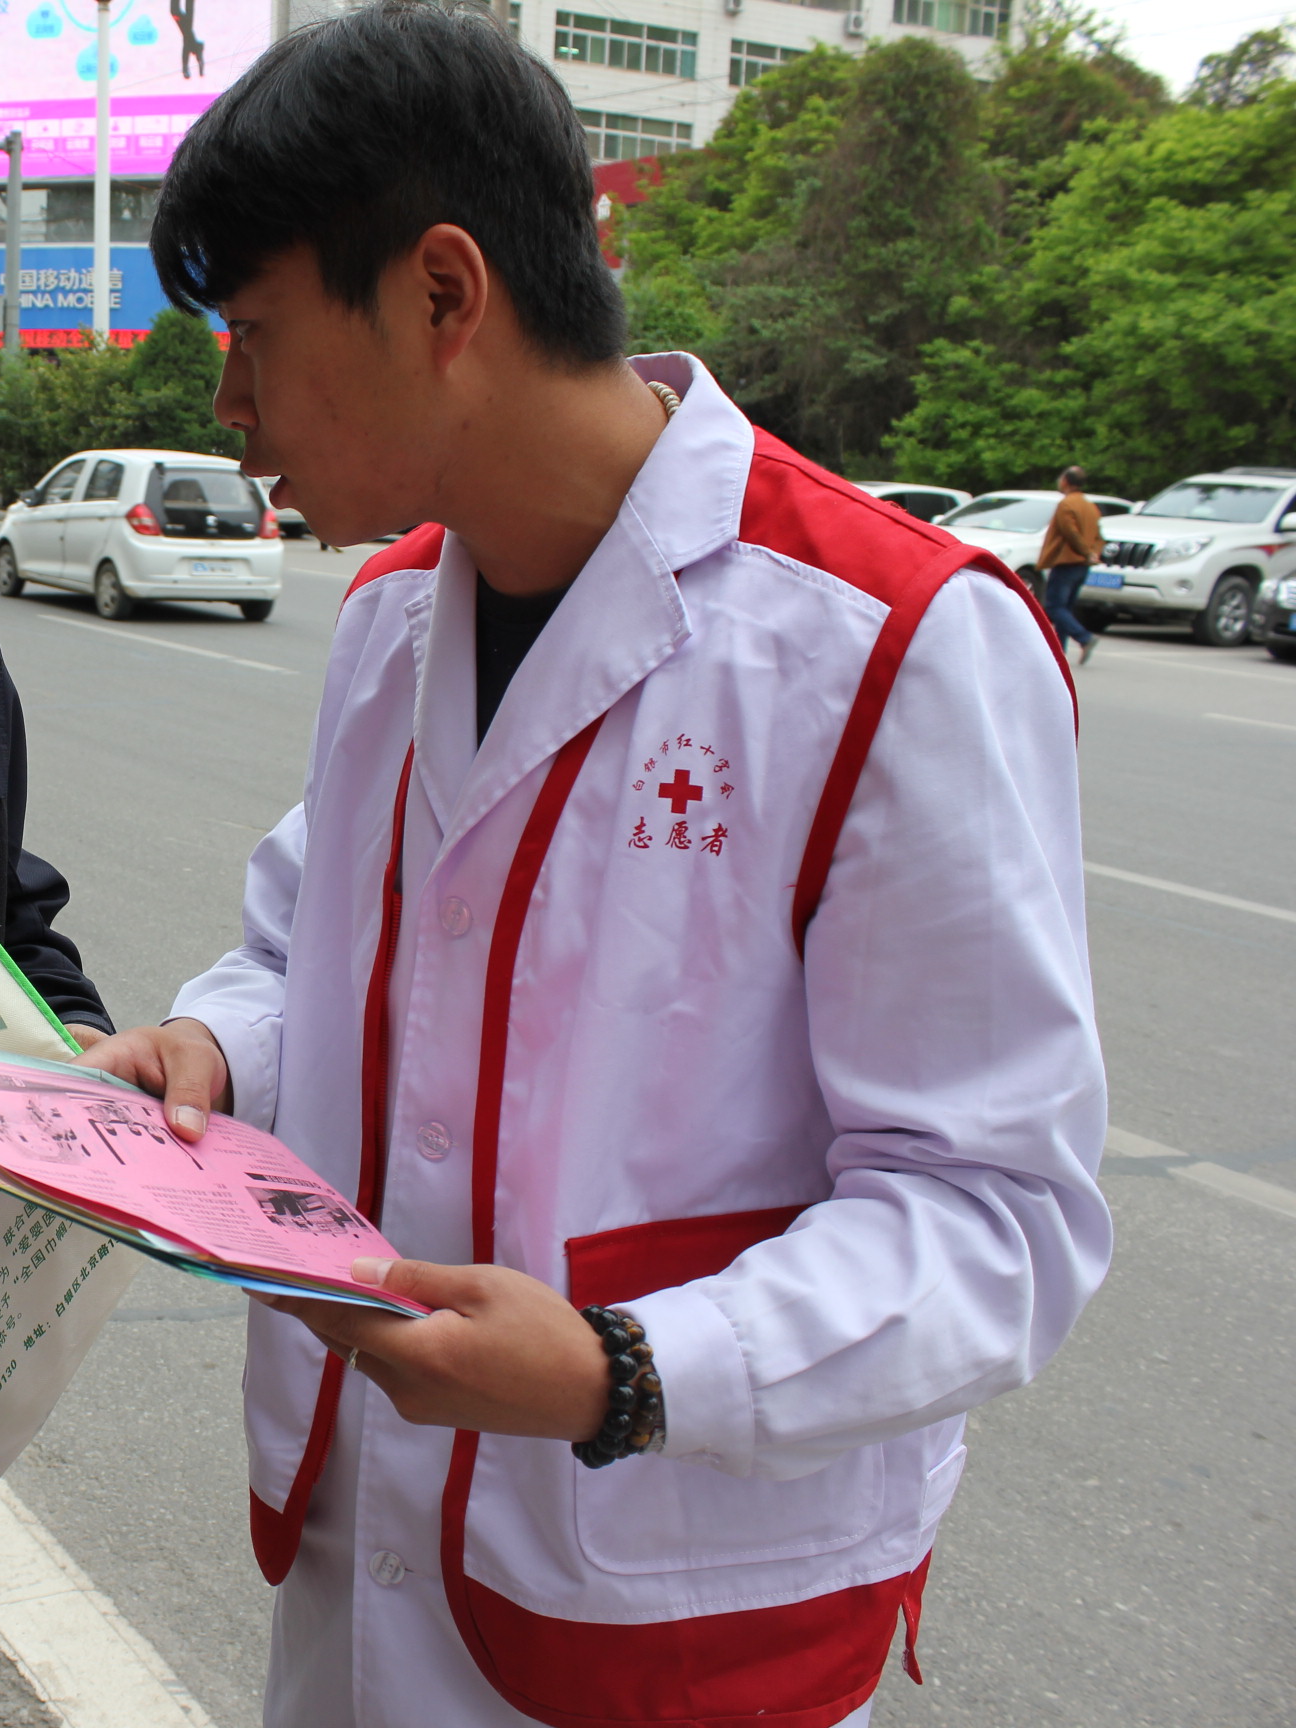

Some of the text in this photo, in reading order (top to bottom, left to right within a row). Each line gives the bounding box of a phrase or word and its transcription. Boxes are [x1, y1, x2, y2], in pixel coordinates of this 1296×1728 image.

[0, 267, 123, 291] 国移动通信
[16, 292, 121, 308] HINA MOBE
[632, 733, 735, 799] 白银市红十字会
[628, 816, 728, 856] 志愿者
[23, 1239, 120, 1351] 地址：白银区北京路1
